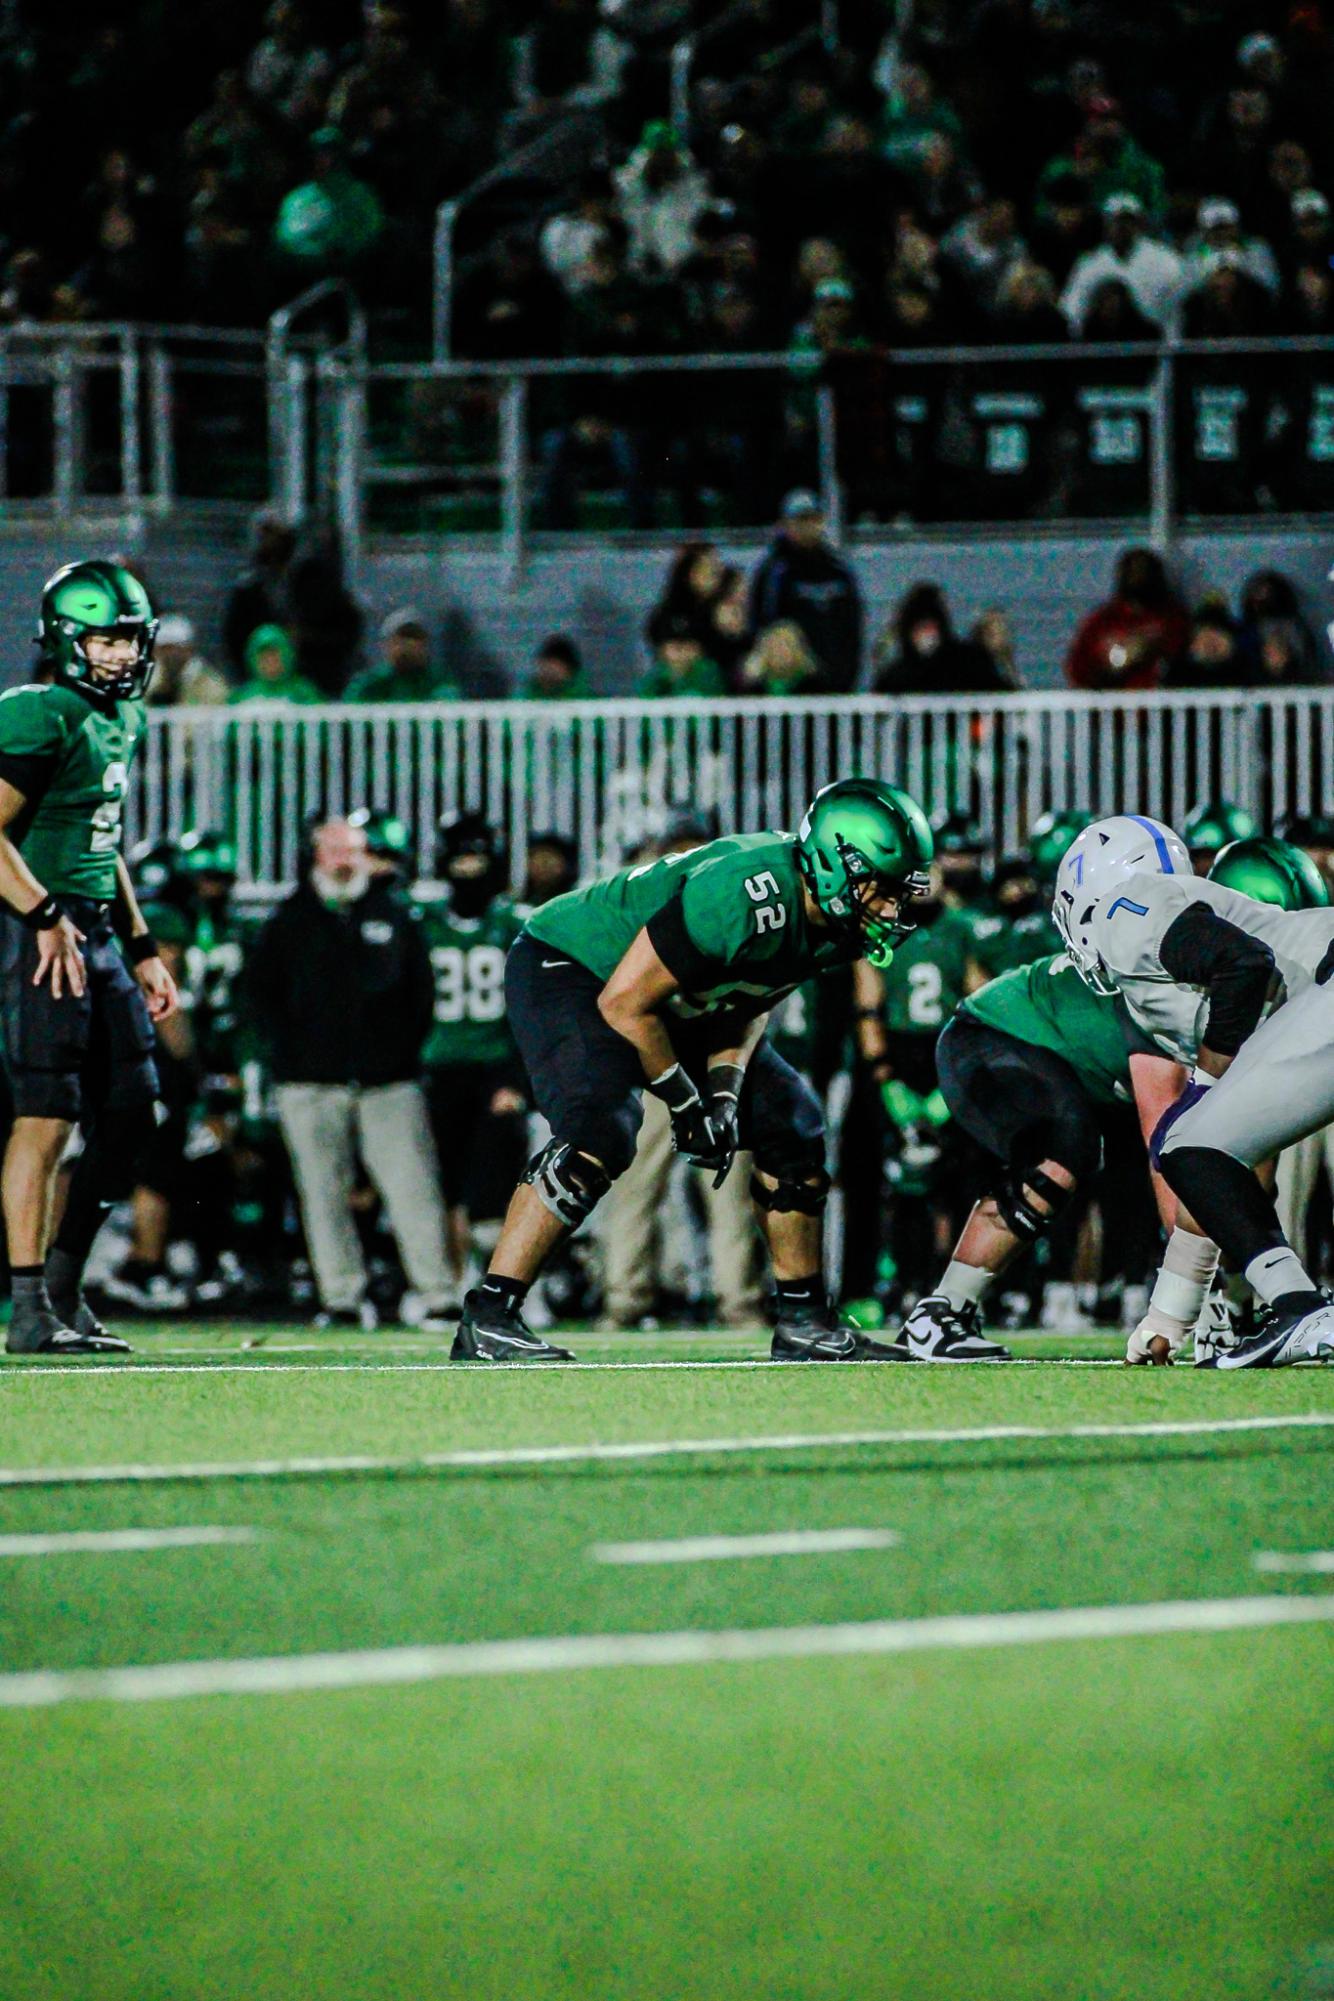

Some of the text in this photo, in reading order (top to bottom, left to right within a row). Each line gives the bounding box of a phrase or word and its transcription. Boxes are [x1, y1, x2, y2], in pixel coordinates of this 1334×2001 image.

[1068, 853, 1084, 888] 7
[744, 870, 786, 934] 52
[1106, 896, 1149, 920] 7
[429, 945, 506, 1022] 38
[908, 963, 942, 1025] 2
